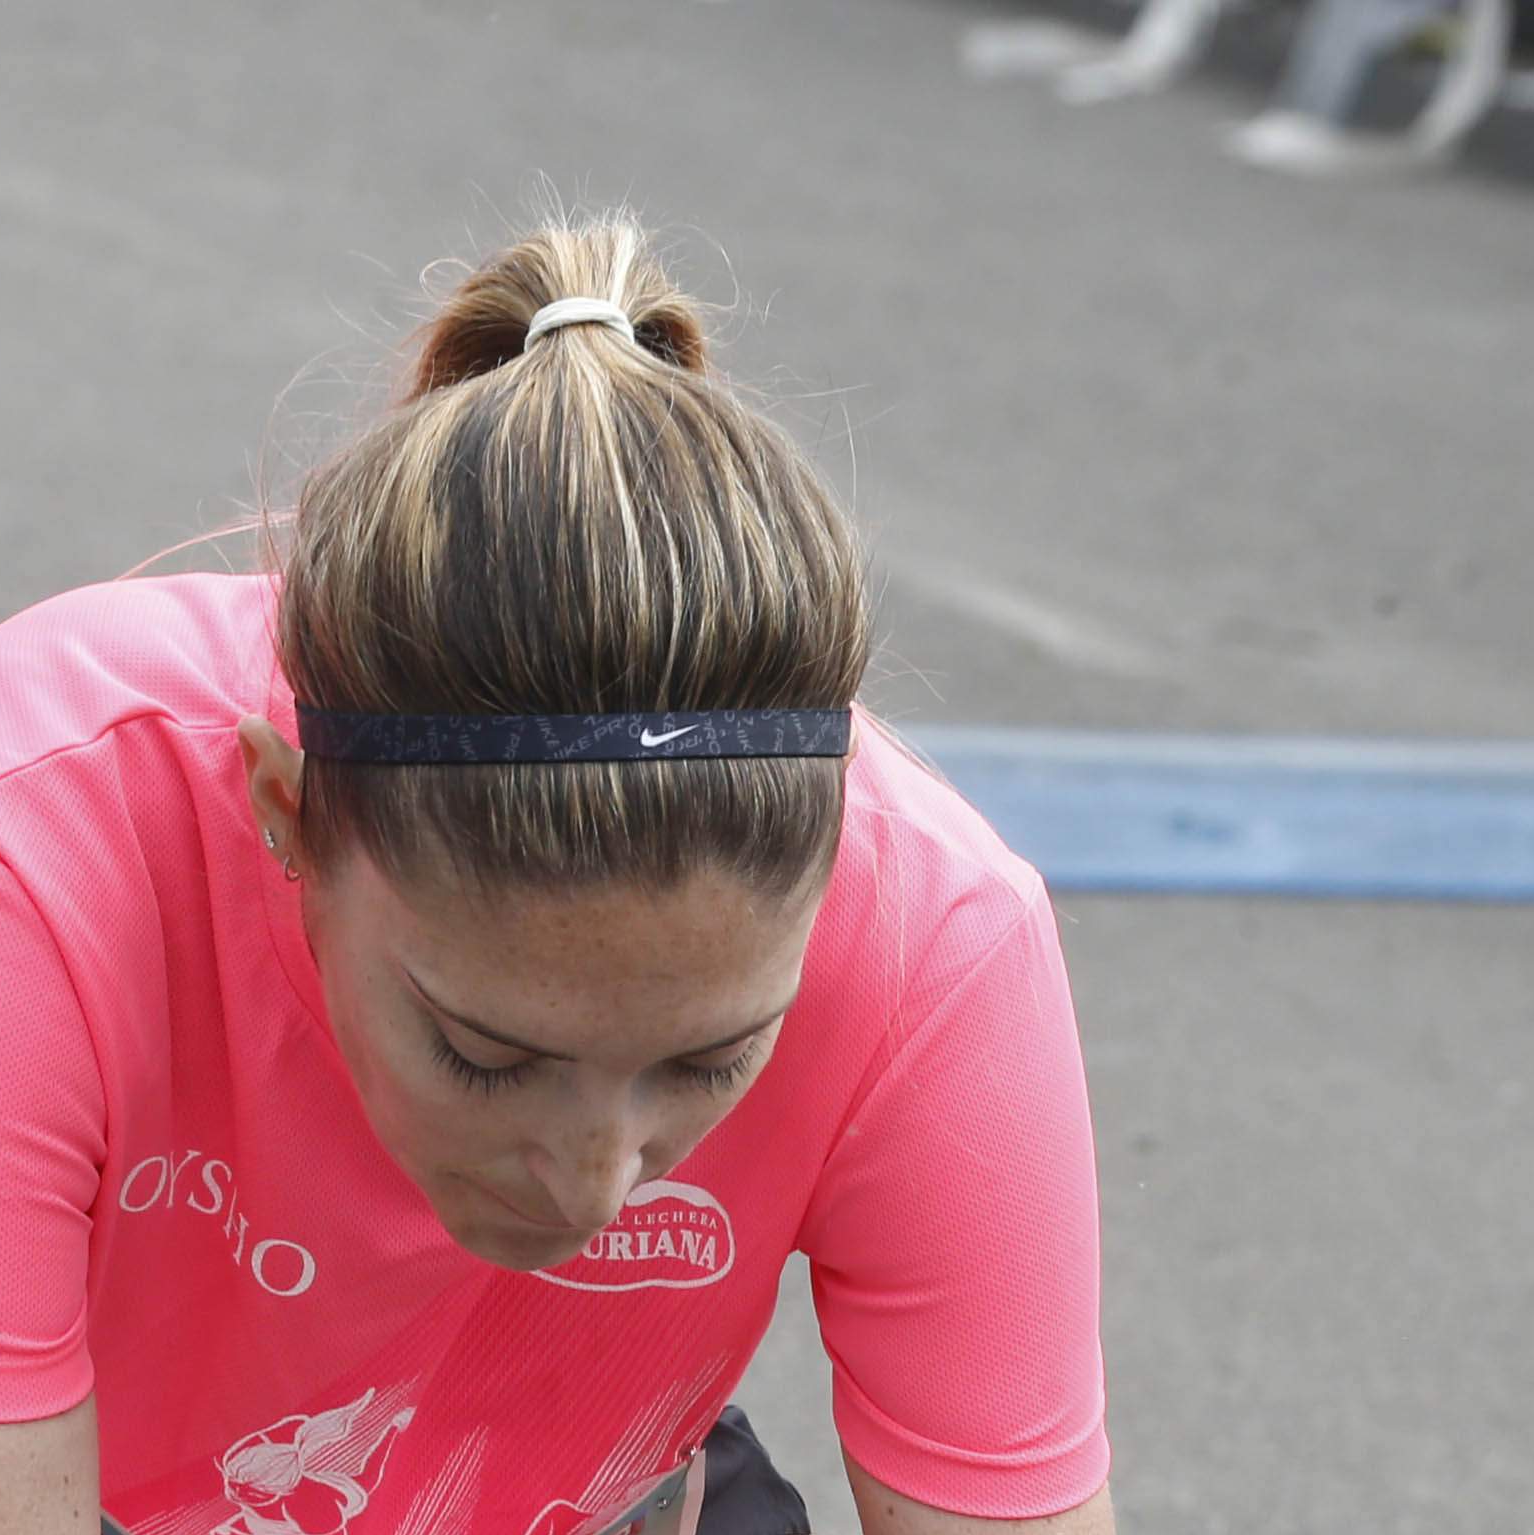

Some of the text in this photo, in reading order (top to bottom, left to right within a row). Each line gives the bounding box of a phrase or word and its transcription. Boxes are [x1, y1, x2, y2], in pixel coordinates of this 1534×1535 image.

[118, 1149, 316, 1297] OYSHO
[634, 1210, 719, 1230] LECHERA
[581, 1229, 717, 1272] URIANA
